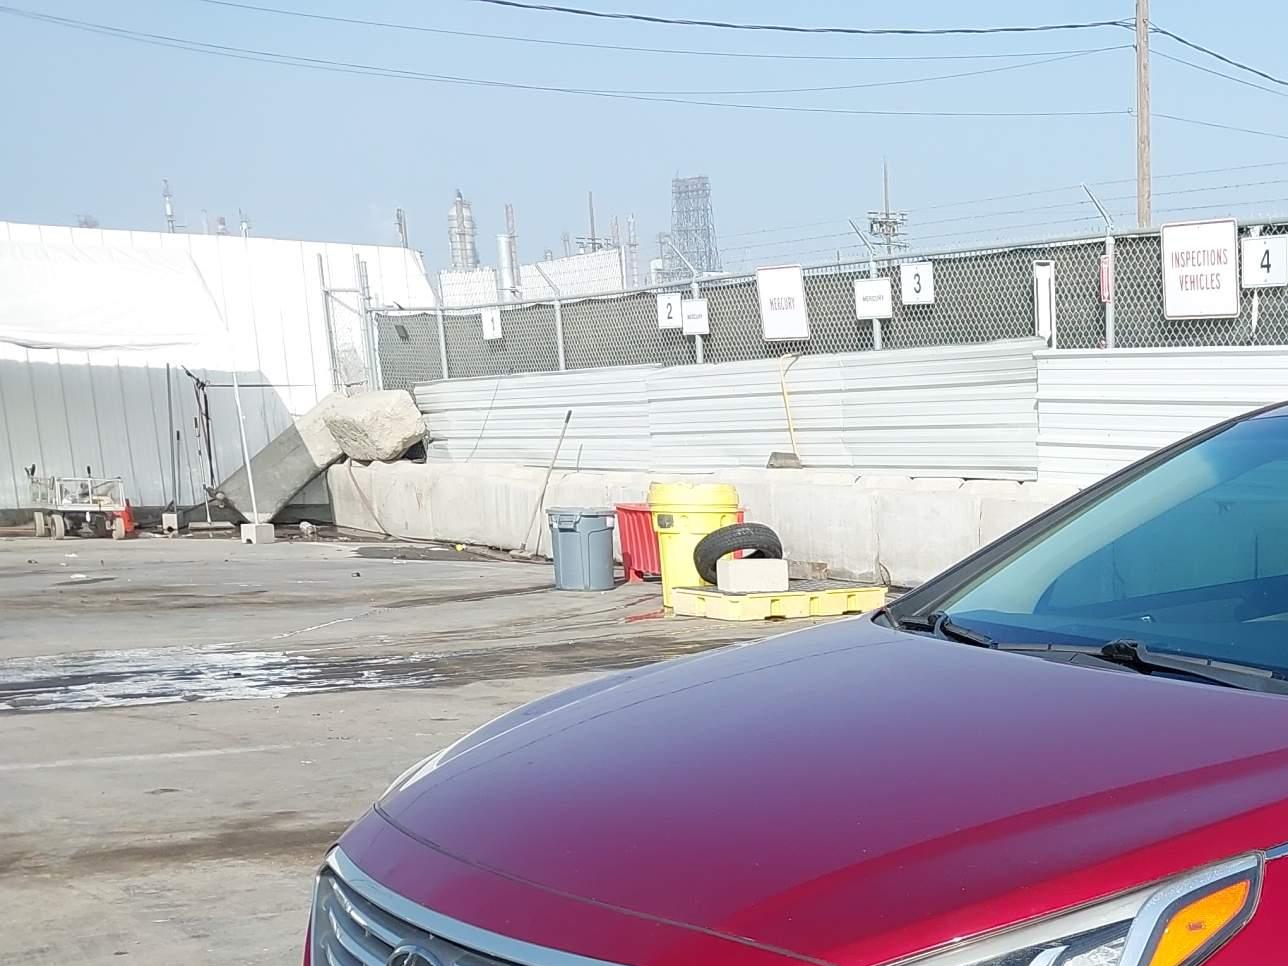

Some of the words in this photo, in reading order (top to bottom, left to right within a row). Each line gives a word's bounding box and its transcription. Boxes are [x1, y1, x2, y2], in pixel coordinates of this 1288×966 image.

[1171, 248, 1228, 269] INSPECTIONS
[1260, 249, 1272, 274] 4
[913, 273, 922, 294] 3
[1179, 273, 1221, 291] VEHICLES
[666, 302, 673, 320] 2
[769, 296, 796, 311] MERCURY
